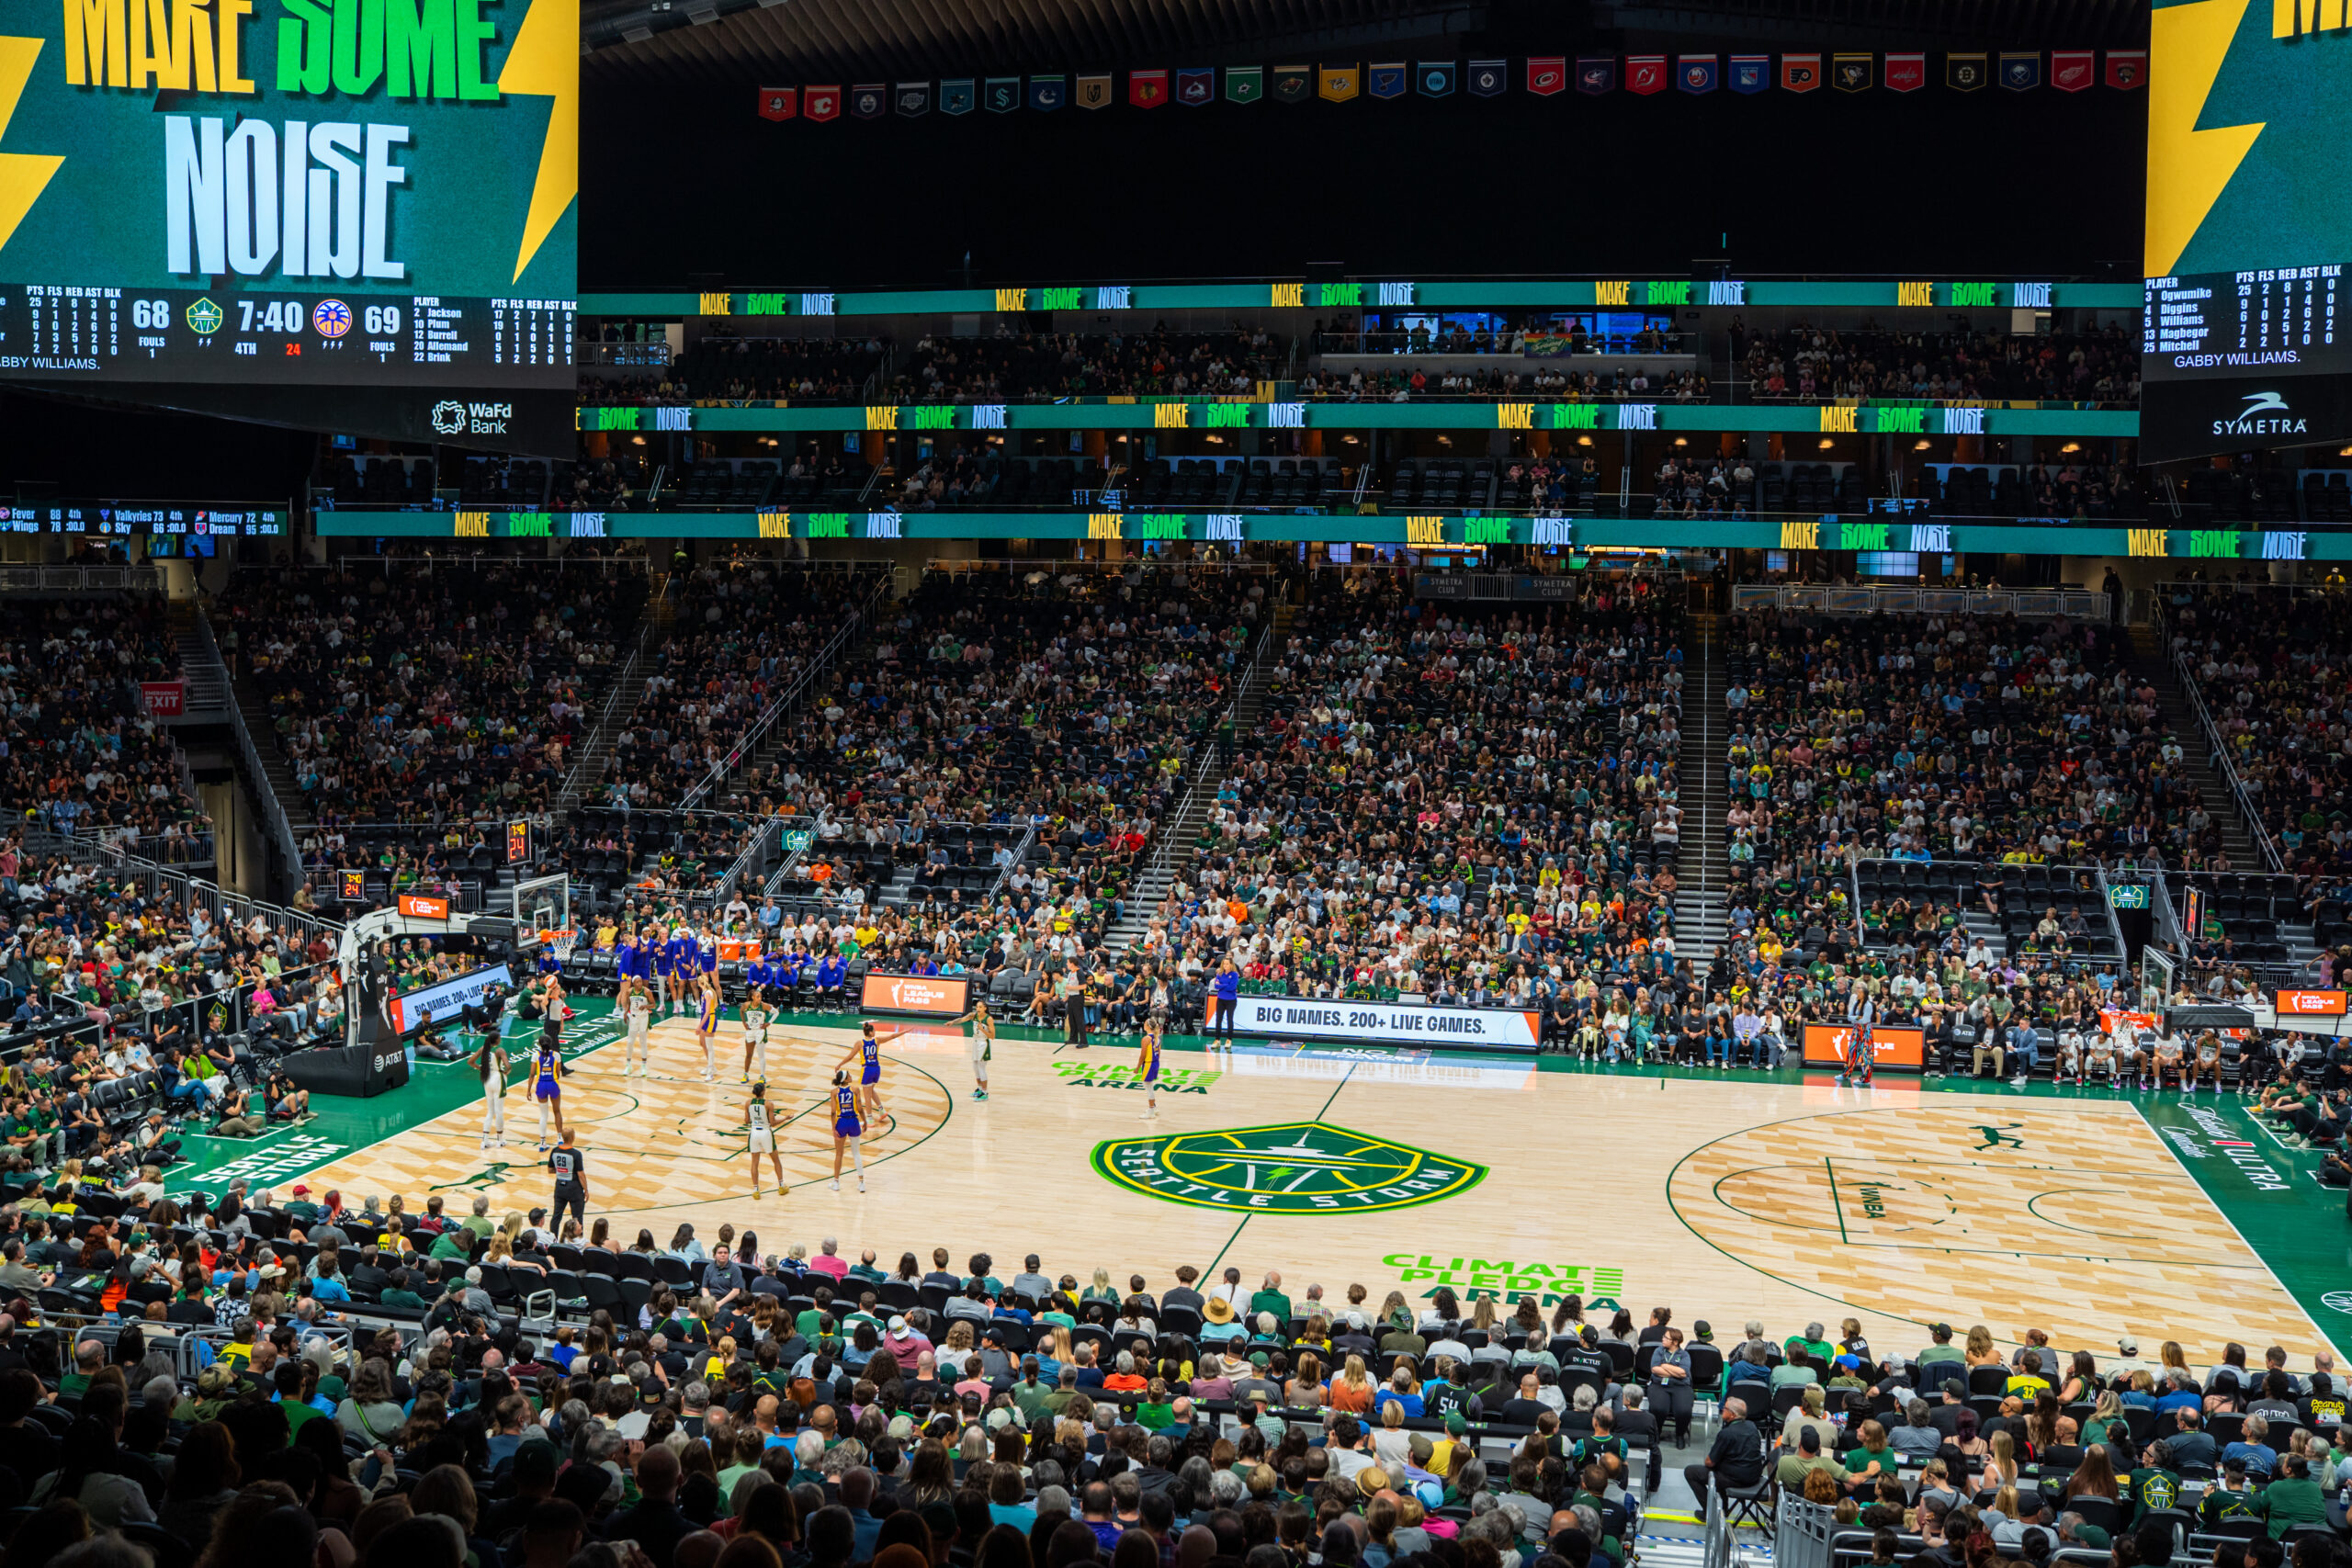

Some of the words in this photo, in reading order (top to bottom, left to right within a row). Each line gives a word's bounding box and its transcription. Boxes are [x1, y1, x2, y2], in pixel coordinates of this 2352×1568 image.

[277, 0, 500, 100] SOME
[165, 115, 409, 278] NOISE
[2145, 277, 2178, 289] PLAYER
[2236, 272, 2255, 284] PTS
[2258, 270, 2275, 282] FLS
[2278, 268, 2297, 280] REB
[2300, 266, 2319, 279] AST
[2322, 265, 2341, 276] BLK
[27, 286, 43, 296] PTS
[48, 287, 62, 297] FLS
[66, 287, 83, 298] REB
[85, 288, 102, 299] AST
[105, 288, 121, 299] BLK
[996, 288, 1027, 311] MAKE
[1044, 288, 1081, 310] SOME
[1098, 287, 1131, 309] NOISE
[1272, 284, 1304, 306] MAKE
[1321, 284, 1362, 306] SOME
[1379, 282, 1414, 305] NOISE
[1595, 281, 1630, 305] MAKE
[1648, 281, 1690, 305] SOME
[1709, 281, 1745, 305] NOISE
[1897, 282, 1933, 306] MAKE
[1952, 283, 1996, 307] SOME
[2014, 283, 2052, 307] NOISE
[2161, 288, 2211, 301] Ogwumike
[413, 297, 439, 307] PLAYER
[492, 299, 507, 309] PTS
[510, 299, 524, 310] FLS
[526, 299, 542, 310] REB
[544, 300, 560, 310] AST
[561, 300, 577, 310] BLK
[700, 294, 730, 315] MAKE
[748, 294, 786, 315] SOME
[802, 294, 834, 315] NOISE
[2160, 303, 2198, 316] Diggins
[133, 300, 169, 329] 68
[238, 300, 303, 333] 7:40
[365, 306, 401, 334] 69
[427, 309, 462, 319] Jackson
[2160, 315, 2203, 327] Williams
[427, 320, 449, 330] Plum
[427, 331, 458, 341] Burrell
[2159, 327, 2209, 341] Magbegor
[139, 336, 165, 347] FOULS
[369, 342, 395, 353] FOULS
[427, 341, 469, 352] Allemand
[2159, 340, 2199, 353] Mitchell
[235, 343, 256, 355] 4TH
[286, 344, 300, 356] 24
[0, 356, 28, 368] BBY
[32, 357, 100, 370] WILLIAMS.
[427, 353, 451, 363] Brink
[2174, 354, 2223, 367] GABBY
[2226, 350, 2301, 366] WILLIAMS.
[469, 403, 512, 418] WaFd
[865, 406, 899, 430] MAKE
[915, 405, 956, 429] SOME
[972, 405, 1007, 429] NOISE
[1155, 403, 1189, 428] MAKE
[1207, 403, 1250, 427] SOME
[1268, 403, 1306, 428] NOISE
[1498, 403, 1534, 429] MAKE
[1554, 403, 1600, 429] SOME
[1618, 404, 1657, 430] NOISE
[599, 408, 639, 430] SOME
[656, 407, 692, 430] NOISE
[1820, 406, 1858, 433] MAKE
[1878, 407, 1924, 434] SOME
[1944, 408, 1984, 434] NOISE
[471, 420, 506, 434] Bank
[2212, 419, 2307, 434] SYMETRA
[12, 509, 35, 520] Fever
[51, 509, 61, 520] 88
[115, 510, 152, 523] Valkyries
[153, 511, 164, 522] 73
[209, 512, 243, 525] Mercury
[246, 513, 256, 524] 72
[13, 521, 39, 534] Wings
[51, 522, 61, 532] 78
[115, 522, 131, 535] Sky
[153, 523, 164, 533] 66
[209, 524, 236, 535] Dream
[245, 525, 256, 535] 95
[454, 512, 490, 536] MAKE
[509, 512, 552, 537] SOME
[571, 512, 606, 537] NOISE
[758, 513, 791, 538] MAKE
[808, 513, 849, 538] SOME
[866, 513, 902, 538] NOISE
[1088, 513, 1124, 539] MAKE
[1143, 514, 1186, 539] SOME
[1206, 514, 1244, 540] NOISE
[1406, 516, 1444, 543] MAKE
[1464, 517, 1511, 544] SOME
[1532, 517, 1572, 545] NOISE
[1781, 522, 1820, 549] MAKE
[1841, 524, 1889, 550] SOME
[1910, 525, 1951, 551] NOISE
[2128, 529, 2168, 557] MAKE
[2190, 530, 2241, 558] SOME
[2262, 531, 2306, 559] NOISE
[1438, 586, 1455, 594] CLUB
[1533, 580, 1572, 588] SYMETRA
[1542, 588, 1562, 596] CLUB
[145, 696, 178, 707] EXIT
[511, 823, 526, 836] 7:40
[509, 838, 525, 860] 24
[346, 874, 362, 884] 7:40
[345, 884, 359, 896] 24
[452, 991, 469, 1004] 200+
[467, 986, 482, 998] LIVE
[904, 990, 944, 998] LEAGUE
[1257, 1007, 1283, 1022] BIG
[1286, 1009, 1345, 1027] NAMES.
[1349, 1011, 1385, 1029] 200+
[1391, 1014, 1423, 1031] LIVE
[1427, 1015, 1487, 1034] GAMES.
[865, 1045, 876, 1055] 10
[385, 1050, 403, 1066] AT&T
[543, 1057, 550, 1066] 2
[1051, 1061, 1224, 1077] CLIMATE
[1067, 1078, 1211, 1094] ARENA
[840, 1093, 853, 1104] 12
[754, 1106, 761, 1117] 4
[189, 1134, 329, 1184] SEATTLE
[242, 1142, 349, 1181] STORM
[557, 1156, 567, 1167] 29
[2223, 1148, 2291, 1190] ULTRA
[1121, 1148, 1274, 1207] SEATTLE
[1313, 1168, 1454, 1208] STORM
[1860, 1188, 1886, 1219] WNBA
[1382, 1254, 1623, 1279] CLIMATE
[1400, 1269, 1623, 1297] PLEDGE
[1419, 1285, 1622, 1312] ARENA
[2022, 1385, 2035, 1399] 32
[1438, 1396, 1459, 1412] 54
[2311, 1399, 2345, 1409] Peanuts
[2312, 1407, 2346, 1416] Records
